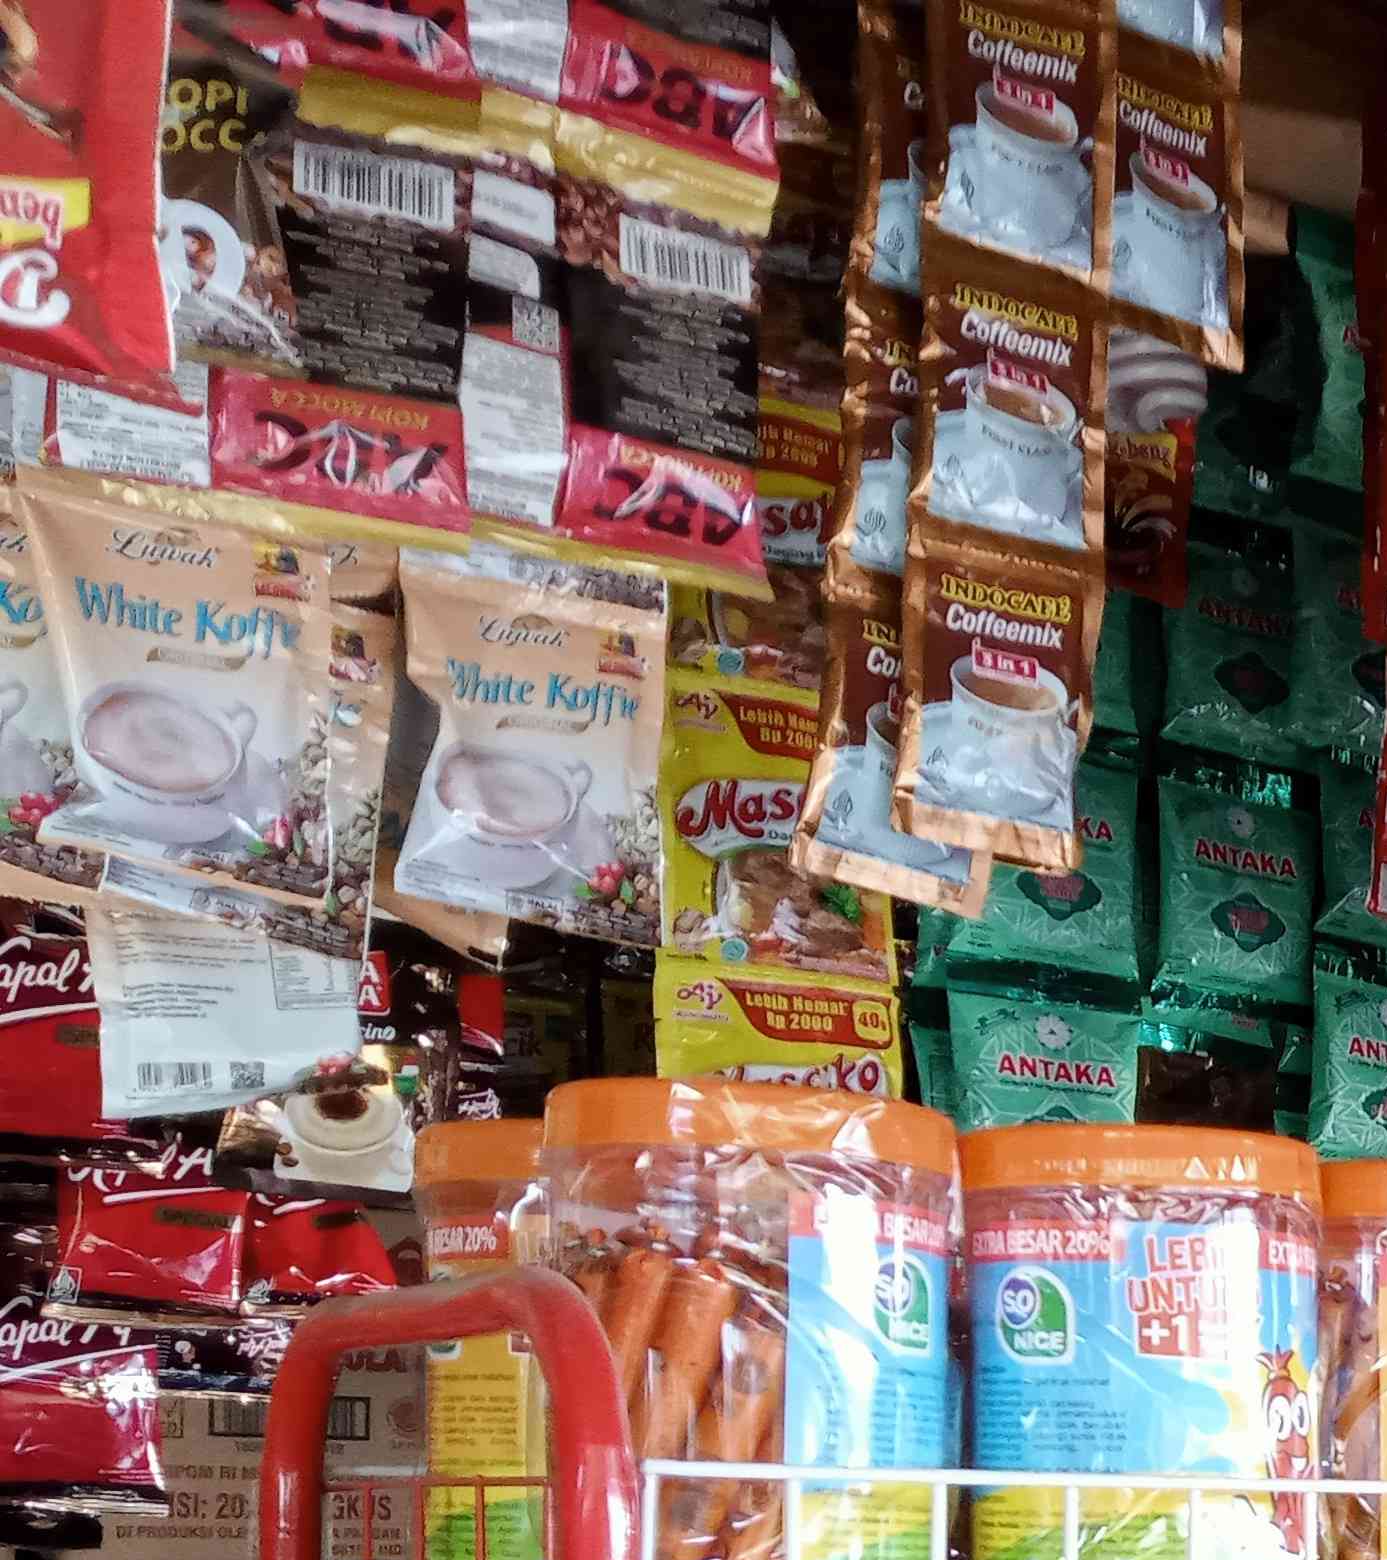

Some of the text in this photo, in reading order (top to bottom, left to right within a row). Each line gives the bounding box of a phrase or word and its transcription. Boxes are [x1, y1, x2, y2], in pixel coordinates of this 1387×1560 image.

[966, 29, 1080, 83] Coffeemix
[161, 117, 269, 154] OCC
[1118, 100, 1209, 158] Coffeemix
[960, 311, 1072, 367] Coffeemix
[74, 576, 183, 635] White
[945, 603, 1065, 650] Coffeemix
[446, 656, 536, 706] White
[676, 778, 801, 836] Mas
[1195, 837, 1298, 881] ANTAKA
[0, 936, 82, 1004] apal
[745, 990, 850, 1016] Lebih Hemat
[789, 1012, 834, 1031] 2000
[998, 1053, 1116, 1089] ANTAKA
[465, 1224, 497, 1252] 20%
[1006, 1230, 1063, 1255] BESAR
[1065, 1229, 1111, 1254] 20%
[1001, 1287, 1034, 1318] SO
[1013, 1331, 1067, 1351] NICE
